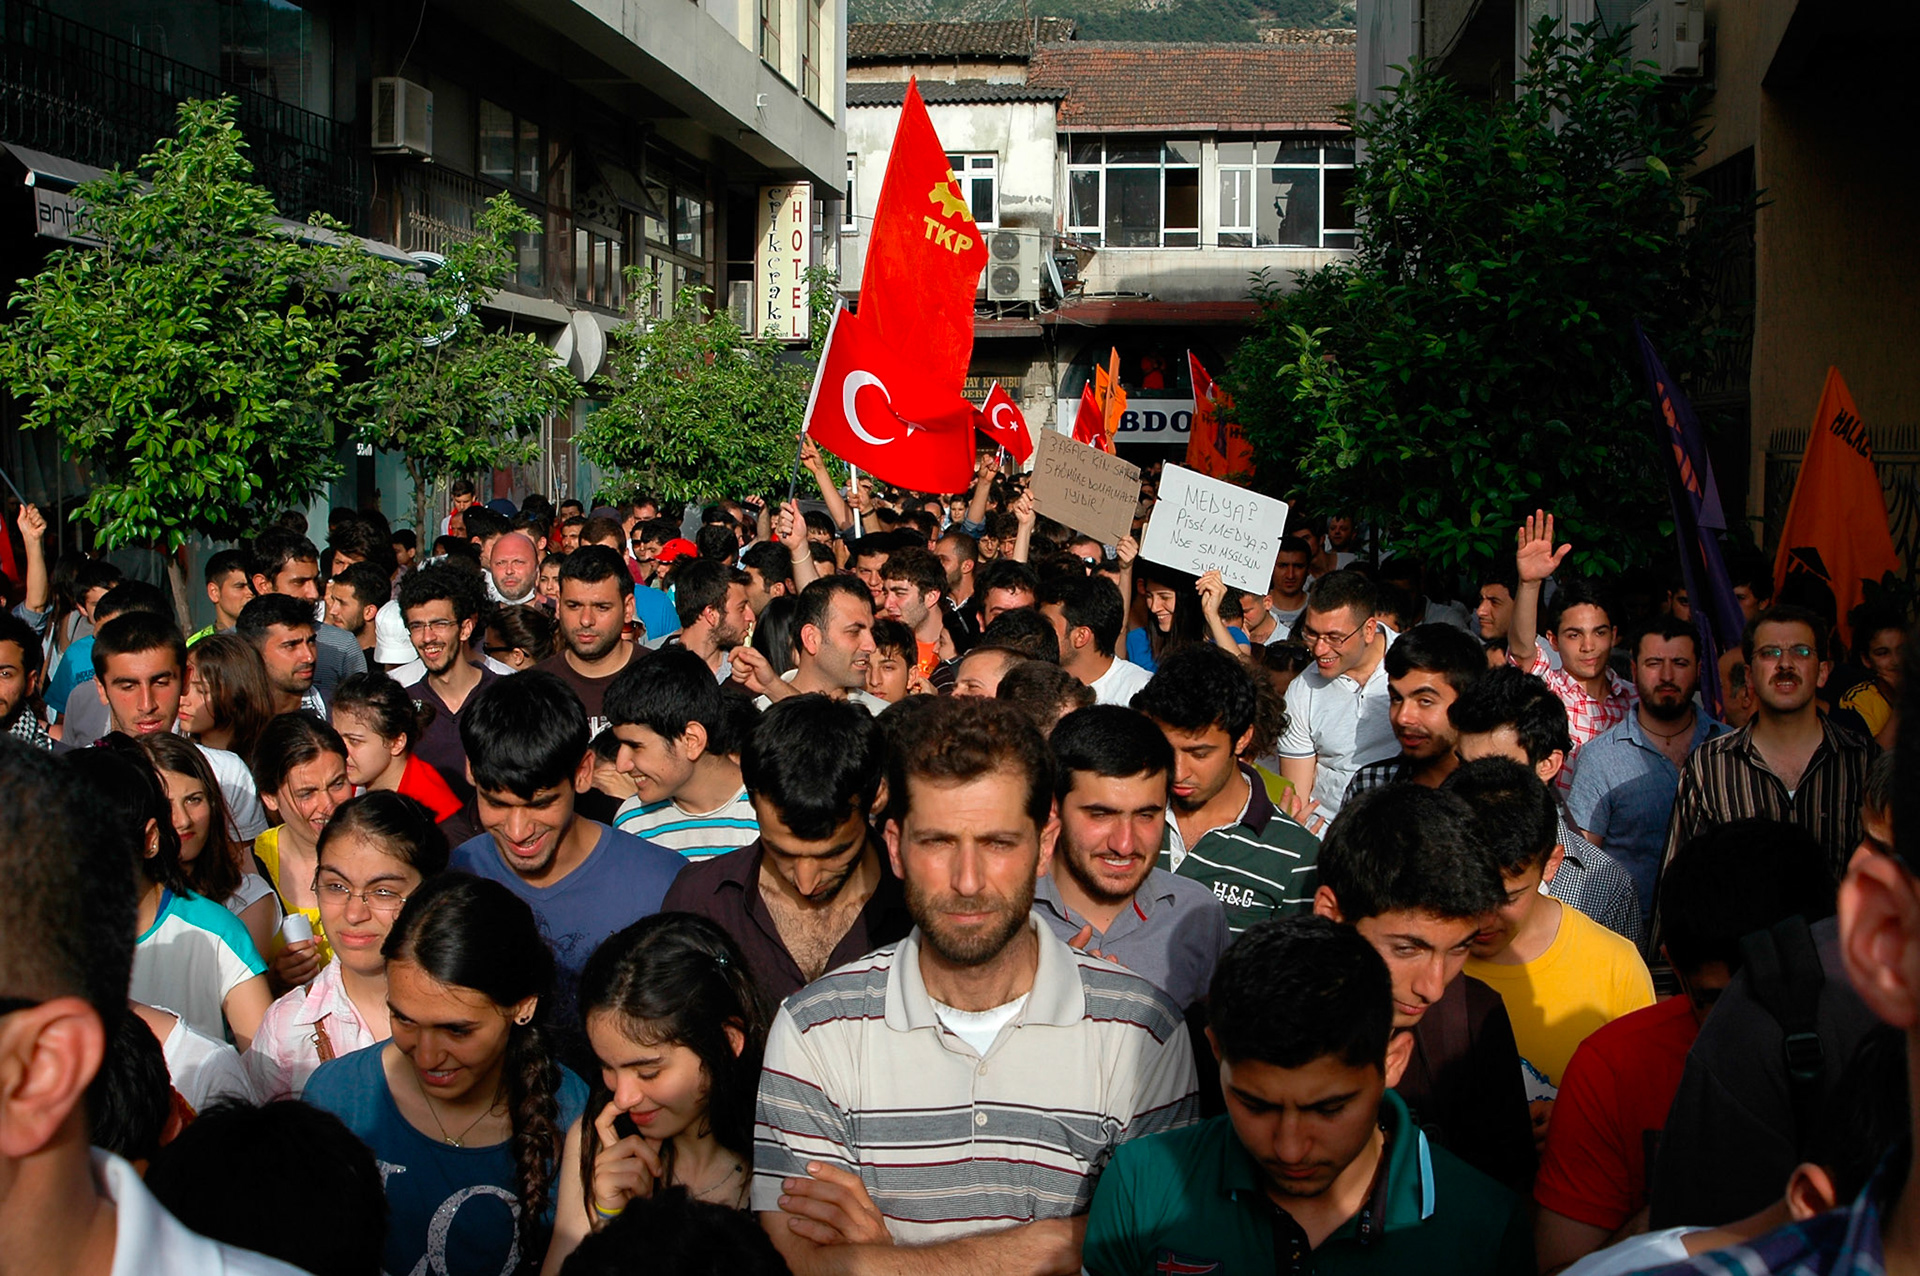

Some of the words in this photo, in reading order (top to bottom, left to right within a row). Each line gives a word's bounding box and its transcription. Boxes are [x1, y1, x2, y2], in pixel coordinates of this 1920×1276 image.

[923, 215, 973, 254] TKP
[792, 201, 803, 337] HOTEL
[1184, 485, 1259, 523] MEDYA?
[1209, 523, 1269, 554] MEDYA?
[1213, 881, 1254, 908] H&G
